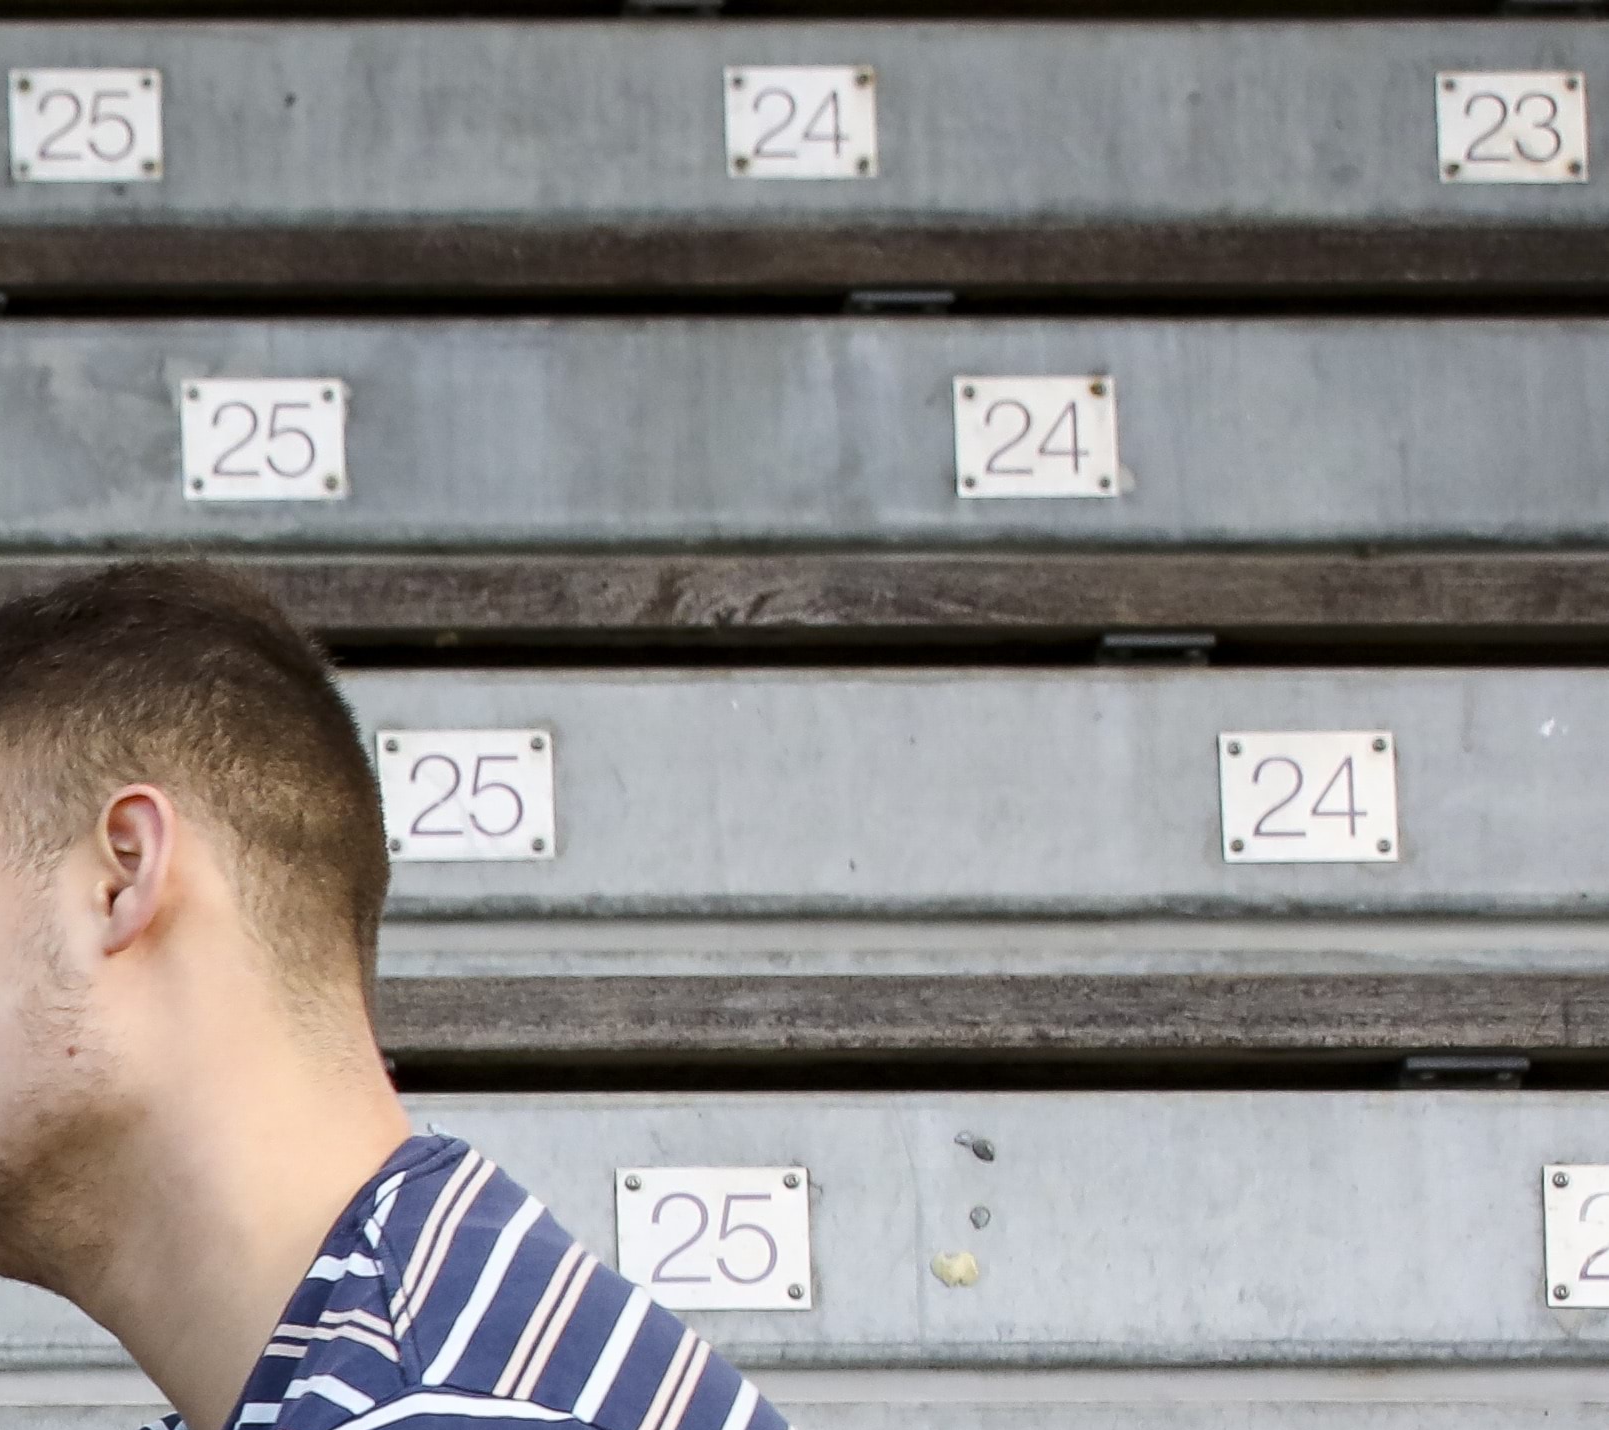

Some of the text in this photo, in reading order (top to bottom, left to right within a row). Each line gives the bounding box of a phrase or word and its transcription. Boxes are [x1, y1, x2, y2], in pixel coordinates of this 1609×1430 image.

[37, 89, 137, 161] 25
[750, 87, 850, 159] 24
[1462, 92, 1563, 163] 23
[211, 401, 317, 479] 25
[982, 399, 1091, 476] 24
[409, 754, 524, 838] 25
[1251, 755, 1368, 838] 24
[650, 1192, 778, 1285] 25
